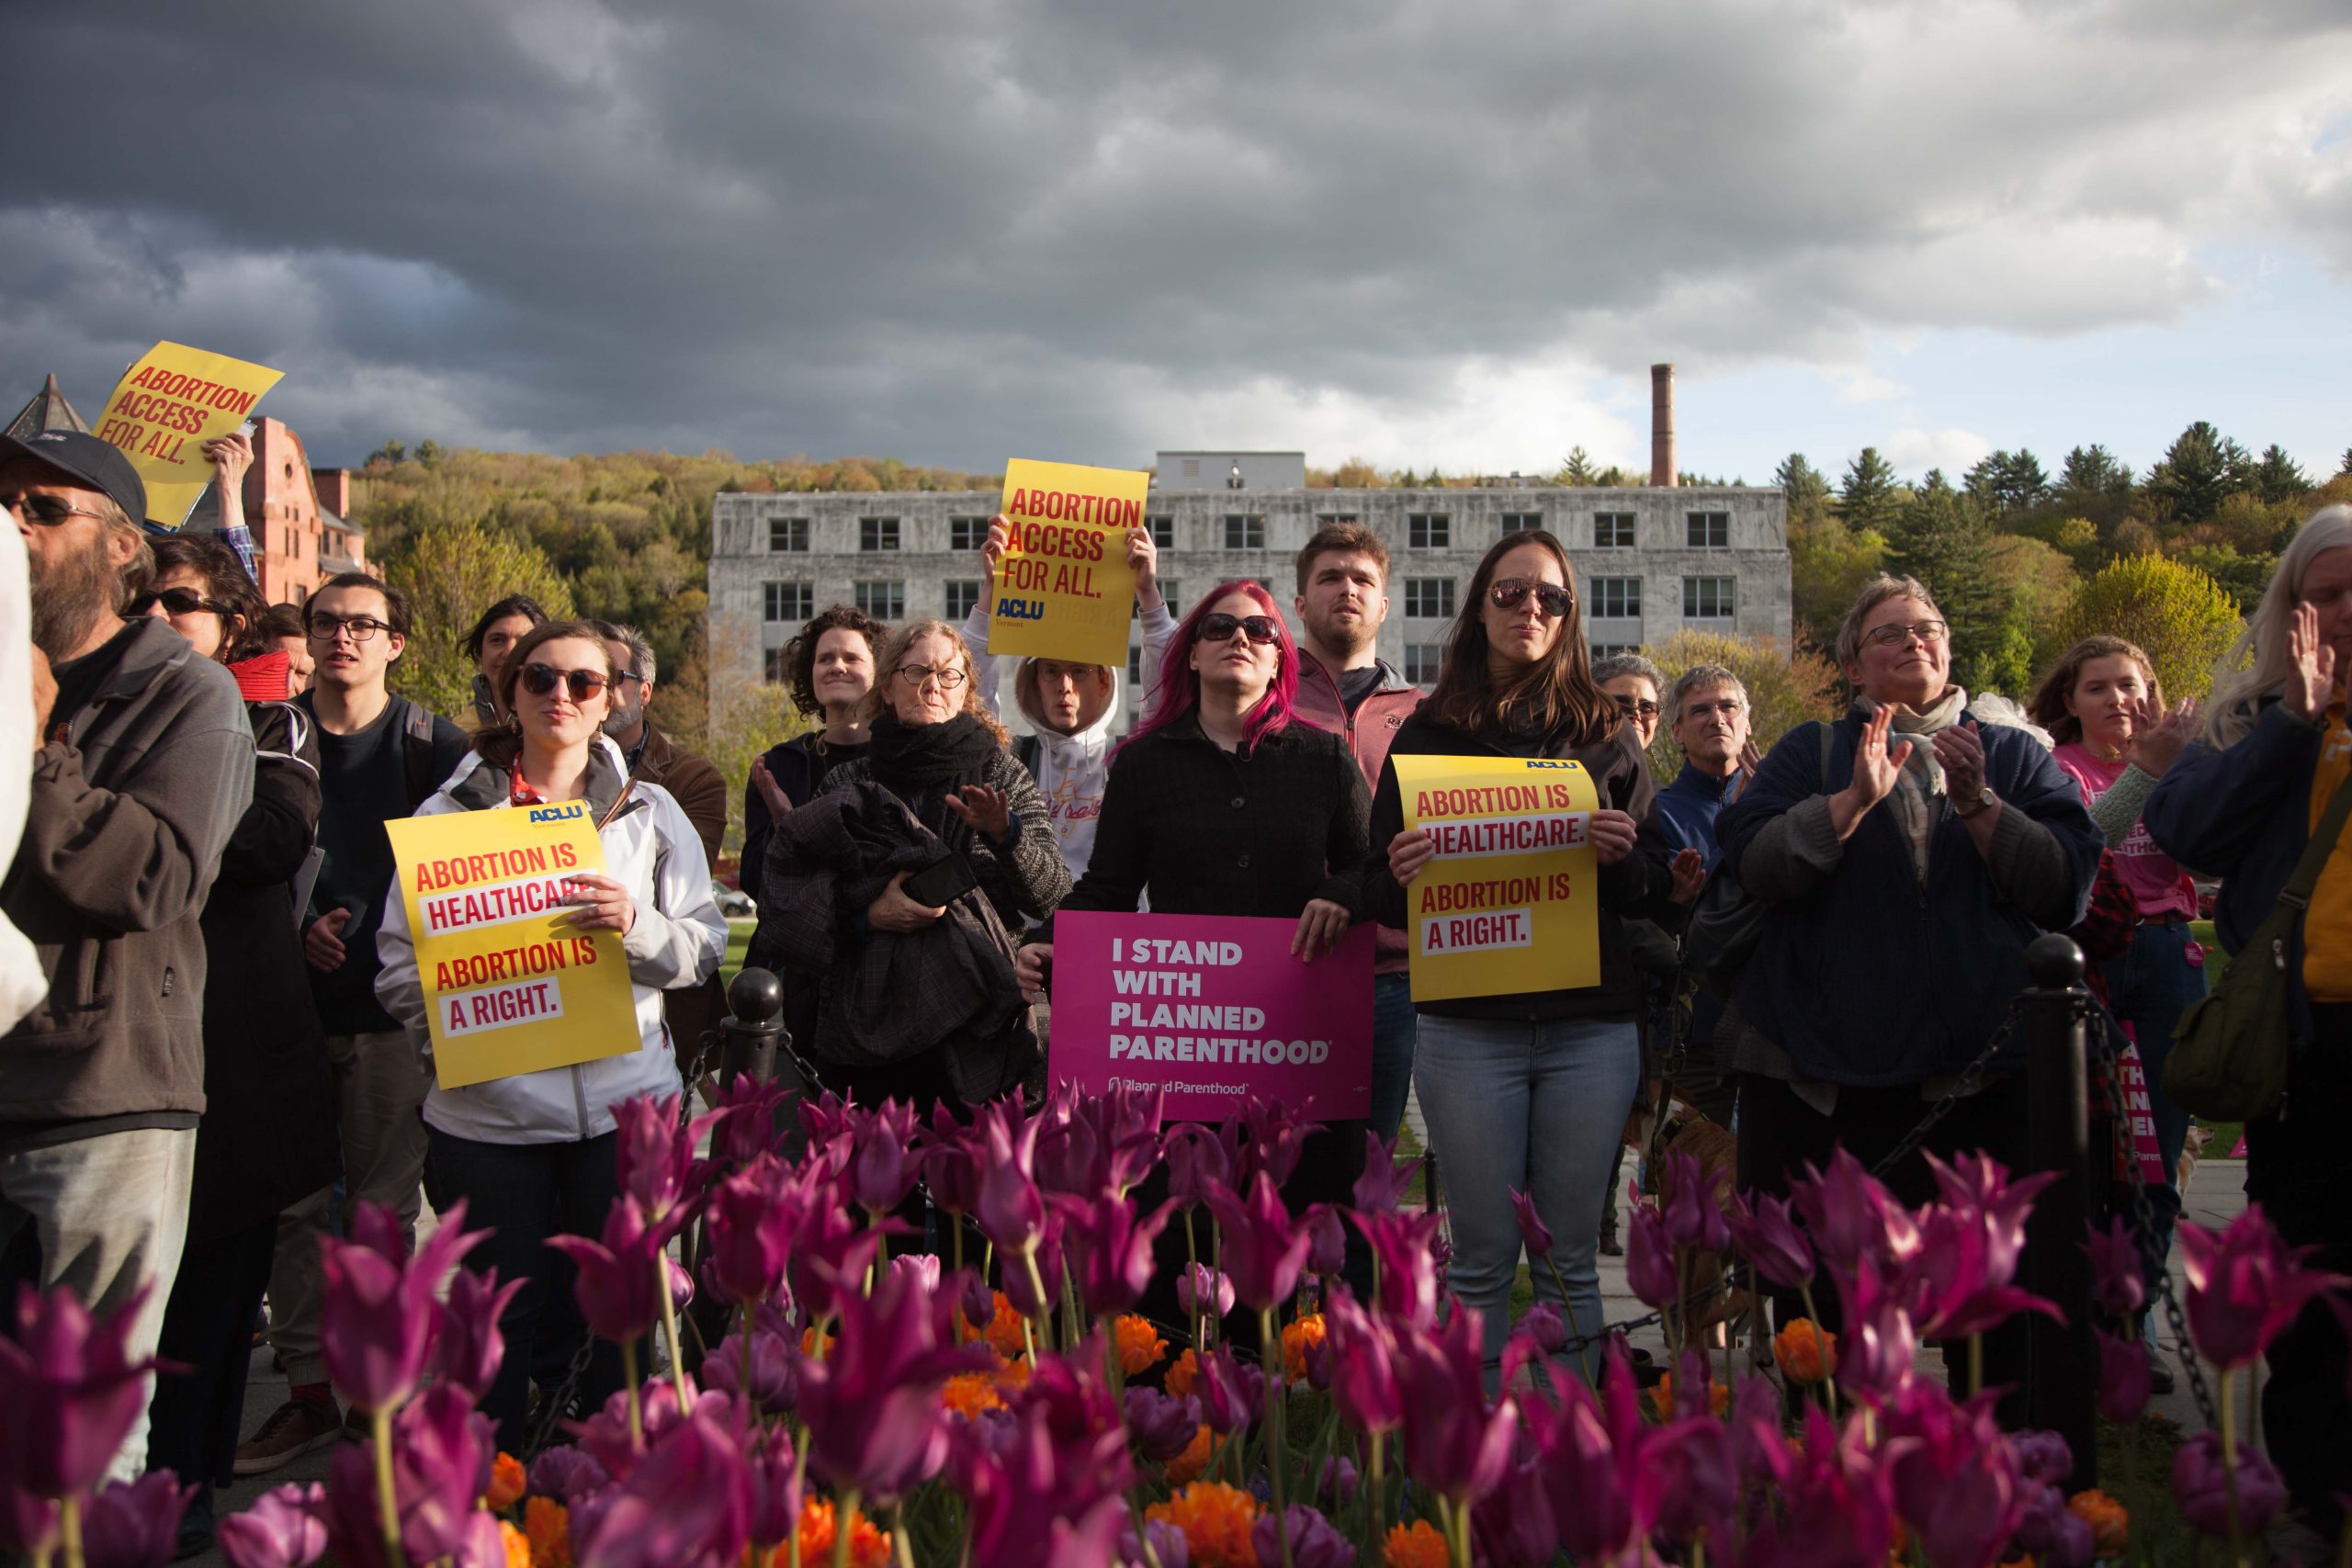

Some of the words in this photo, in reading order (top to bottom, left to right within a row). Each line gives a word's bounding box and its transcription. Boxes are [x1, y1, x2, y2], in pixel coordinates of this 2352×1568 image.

[130, 366, 257, 416] ABORTION
[112, 389, 209, 434] ACCESS
[98, 418, 144, 451] FOR
[140, 431, 186, 465] ALL.
[1010, 488, 1141, 528] ABORTION
[1005, 521, 1105, 561] ACCESS
[1003, 558, 1048, 592] FOR
[1053, 564, 1102, 599] ALL.
[995, 619, 1023, 628] Vermont
[996, 598, 1045, 620] ACLU
[1526, 761, 1578, 769] ACLU
[529, 805, 583, 823] ACLU
[1417, 785, 1540, 818] ABORTION
[1546, 784, 1570, 808] IS
[1426, 818, 1585, 854] HEALTHCARE.
[416, 847, 548, 892] ABORTION
[550, 842, 577, 868] IS
[428, 877, 590, 931] HEALTHCAR
[1420, 876, 1541, 913] ABORTION
[1548, 873, 1570, 900] IS
[1112, 938, 1122, 962] I
[1131, 939, 1242, 966] STAND
[1428, 922, 1443, 950] A
[1450, 914, 1526, 947] RIGHT.
[436, 941, 566, 991] ABORTION
[571, 935, 597, 965] IS
[1113, 970, 1201, 997] WITH
[450, 999, 468, 1031] A
[472, 983, 557, 1026] RIGHT.
[1111, 1002, 1265, 1032] PLANNED
